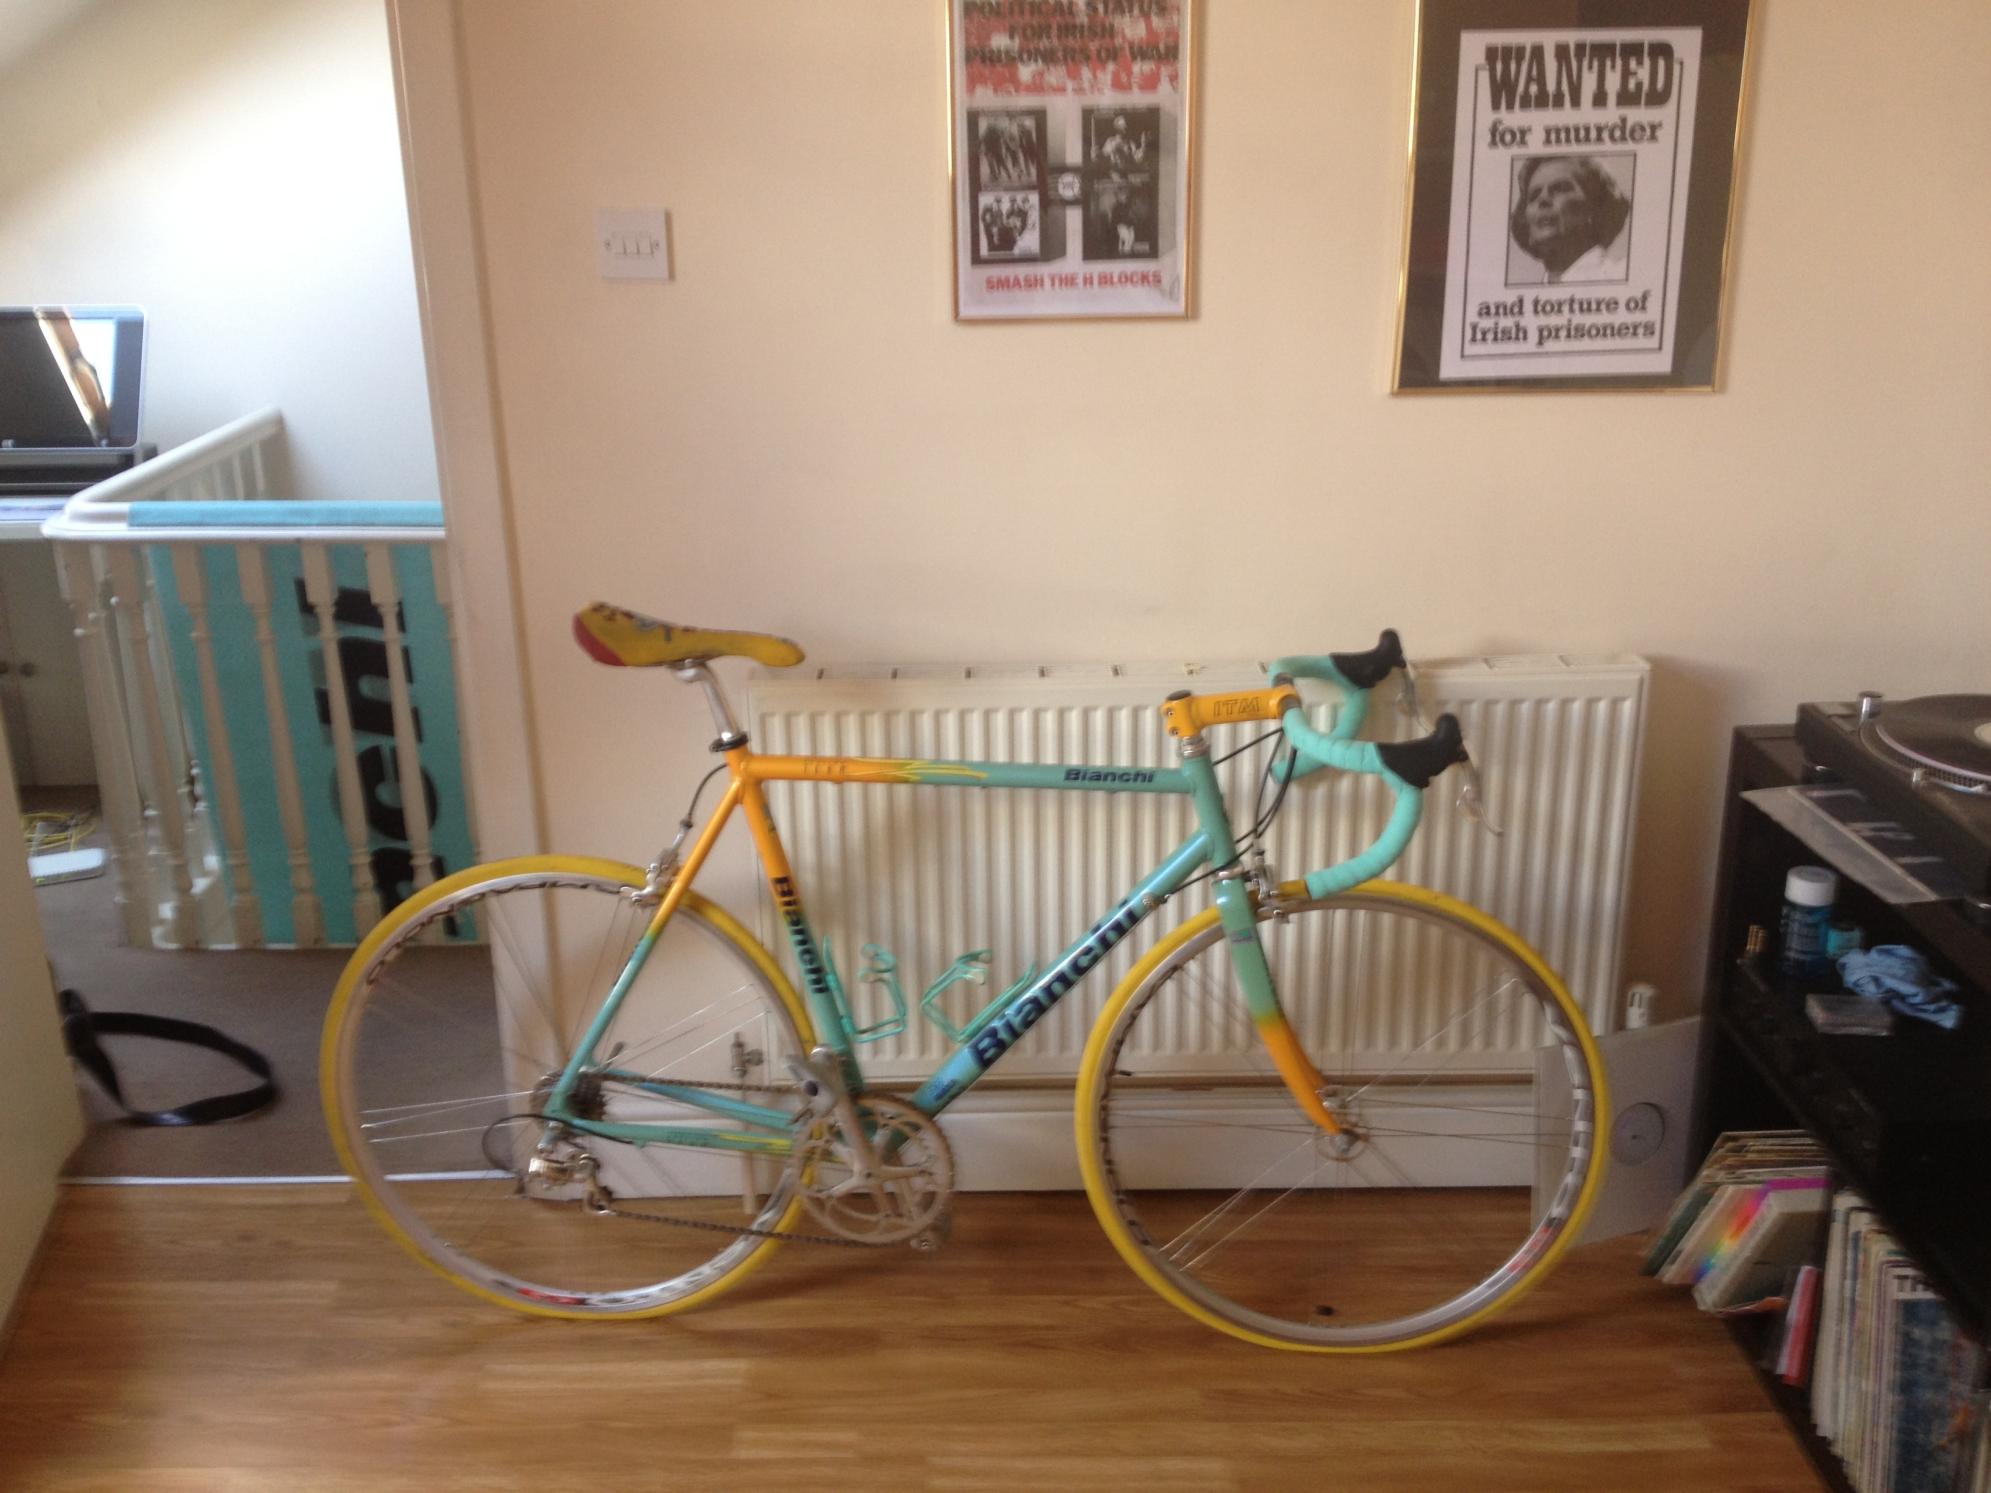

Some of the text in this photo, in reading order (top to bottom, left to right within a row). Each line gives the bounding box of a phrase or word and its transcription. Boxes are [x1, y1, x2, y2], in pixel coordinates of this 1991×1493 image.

[1485, 40, 1675, 112] WANTED
[1488, 113, 1663, 148] for murder
[985, 269, 1162, 292] SMASH THE H BLOCKS
[1477, 289, 1651, 318] and torture of
[1468, 318, 1656, 347] Irish prisoners
[1213, 696, 1260, 717] ITM
[1064, 768, 1155, 784] Bianchi
[772, 876, 831, 994] Bianchi
[967, 896, 1140, 1068] Bianchi
